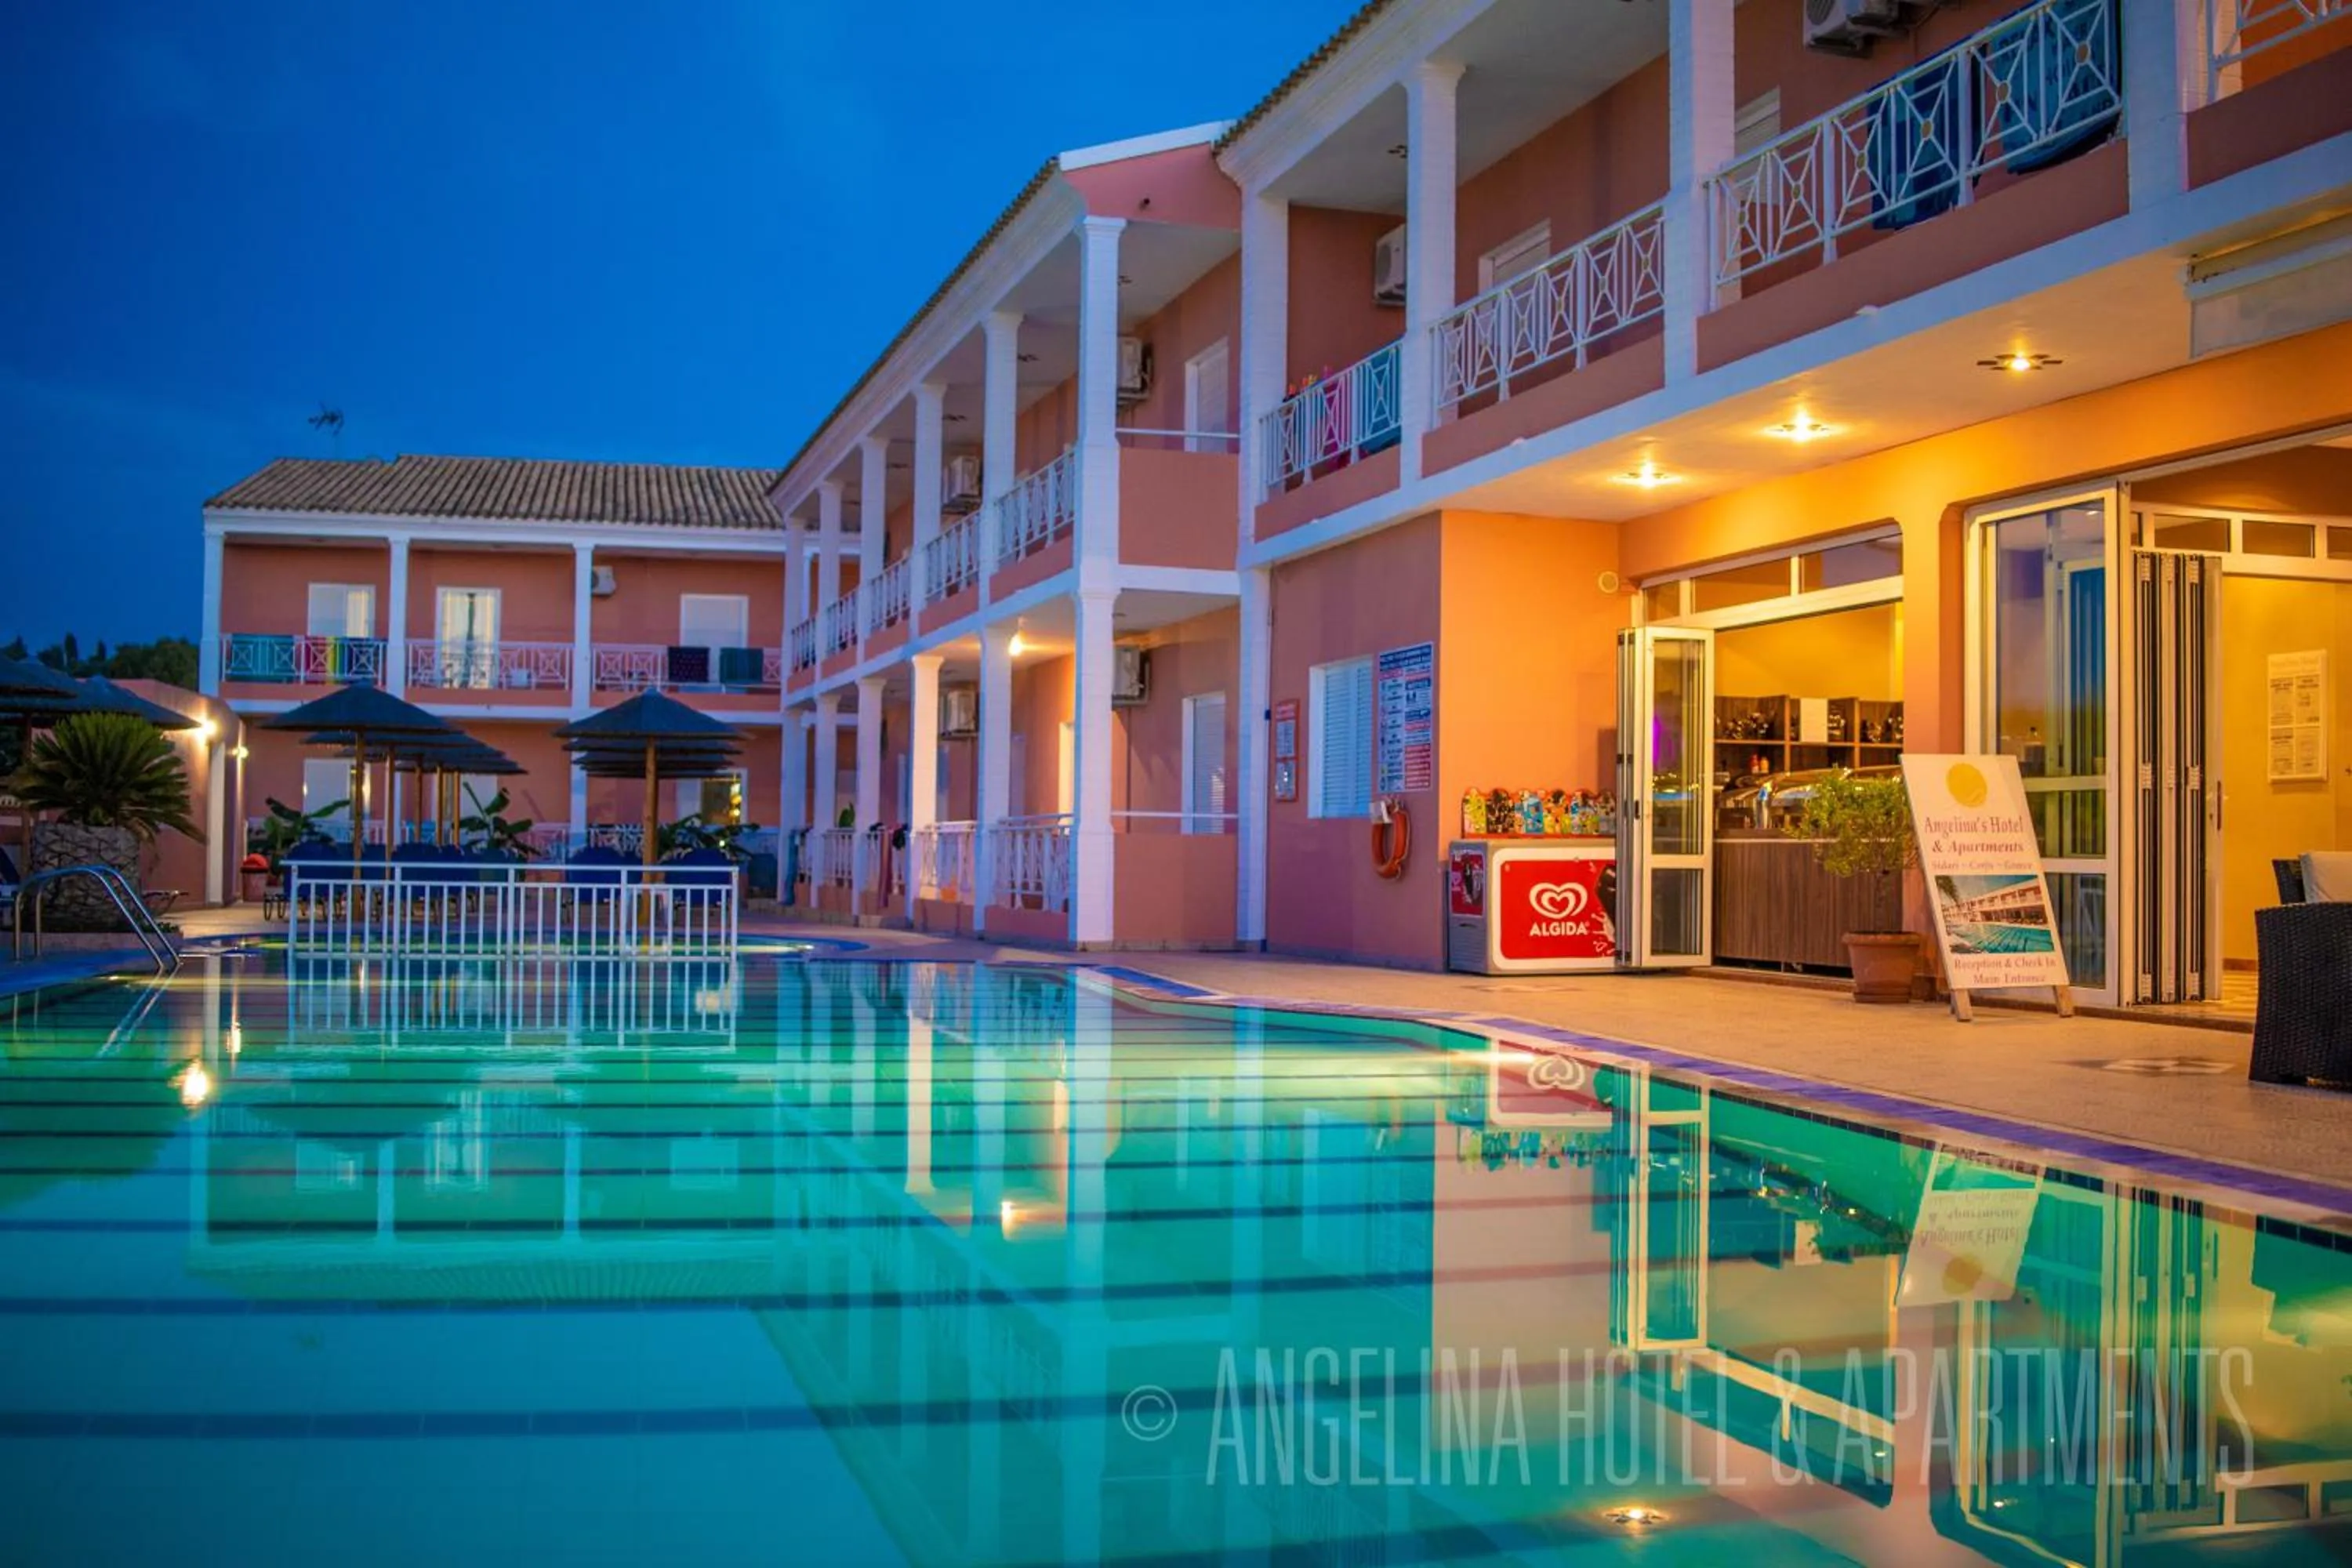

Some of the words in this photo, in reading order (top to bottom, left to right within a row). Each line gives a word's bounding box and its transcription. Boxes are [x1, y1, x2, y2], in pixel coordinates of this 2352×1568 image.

[1989, 815, 2024, 833] Hotel
[1932, 840, 1943, 853] &
[1947, 840, 2024, 856] Apartments
[1530, 921, 1588, 936] ALGIDA
[1954, 958, 2002, 972] Reception
[2004, 957, 2013, 968] &
[2014, 956, 2043, 968] Check
